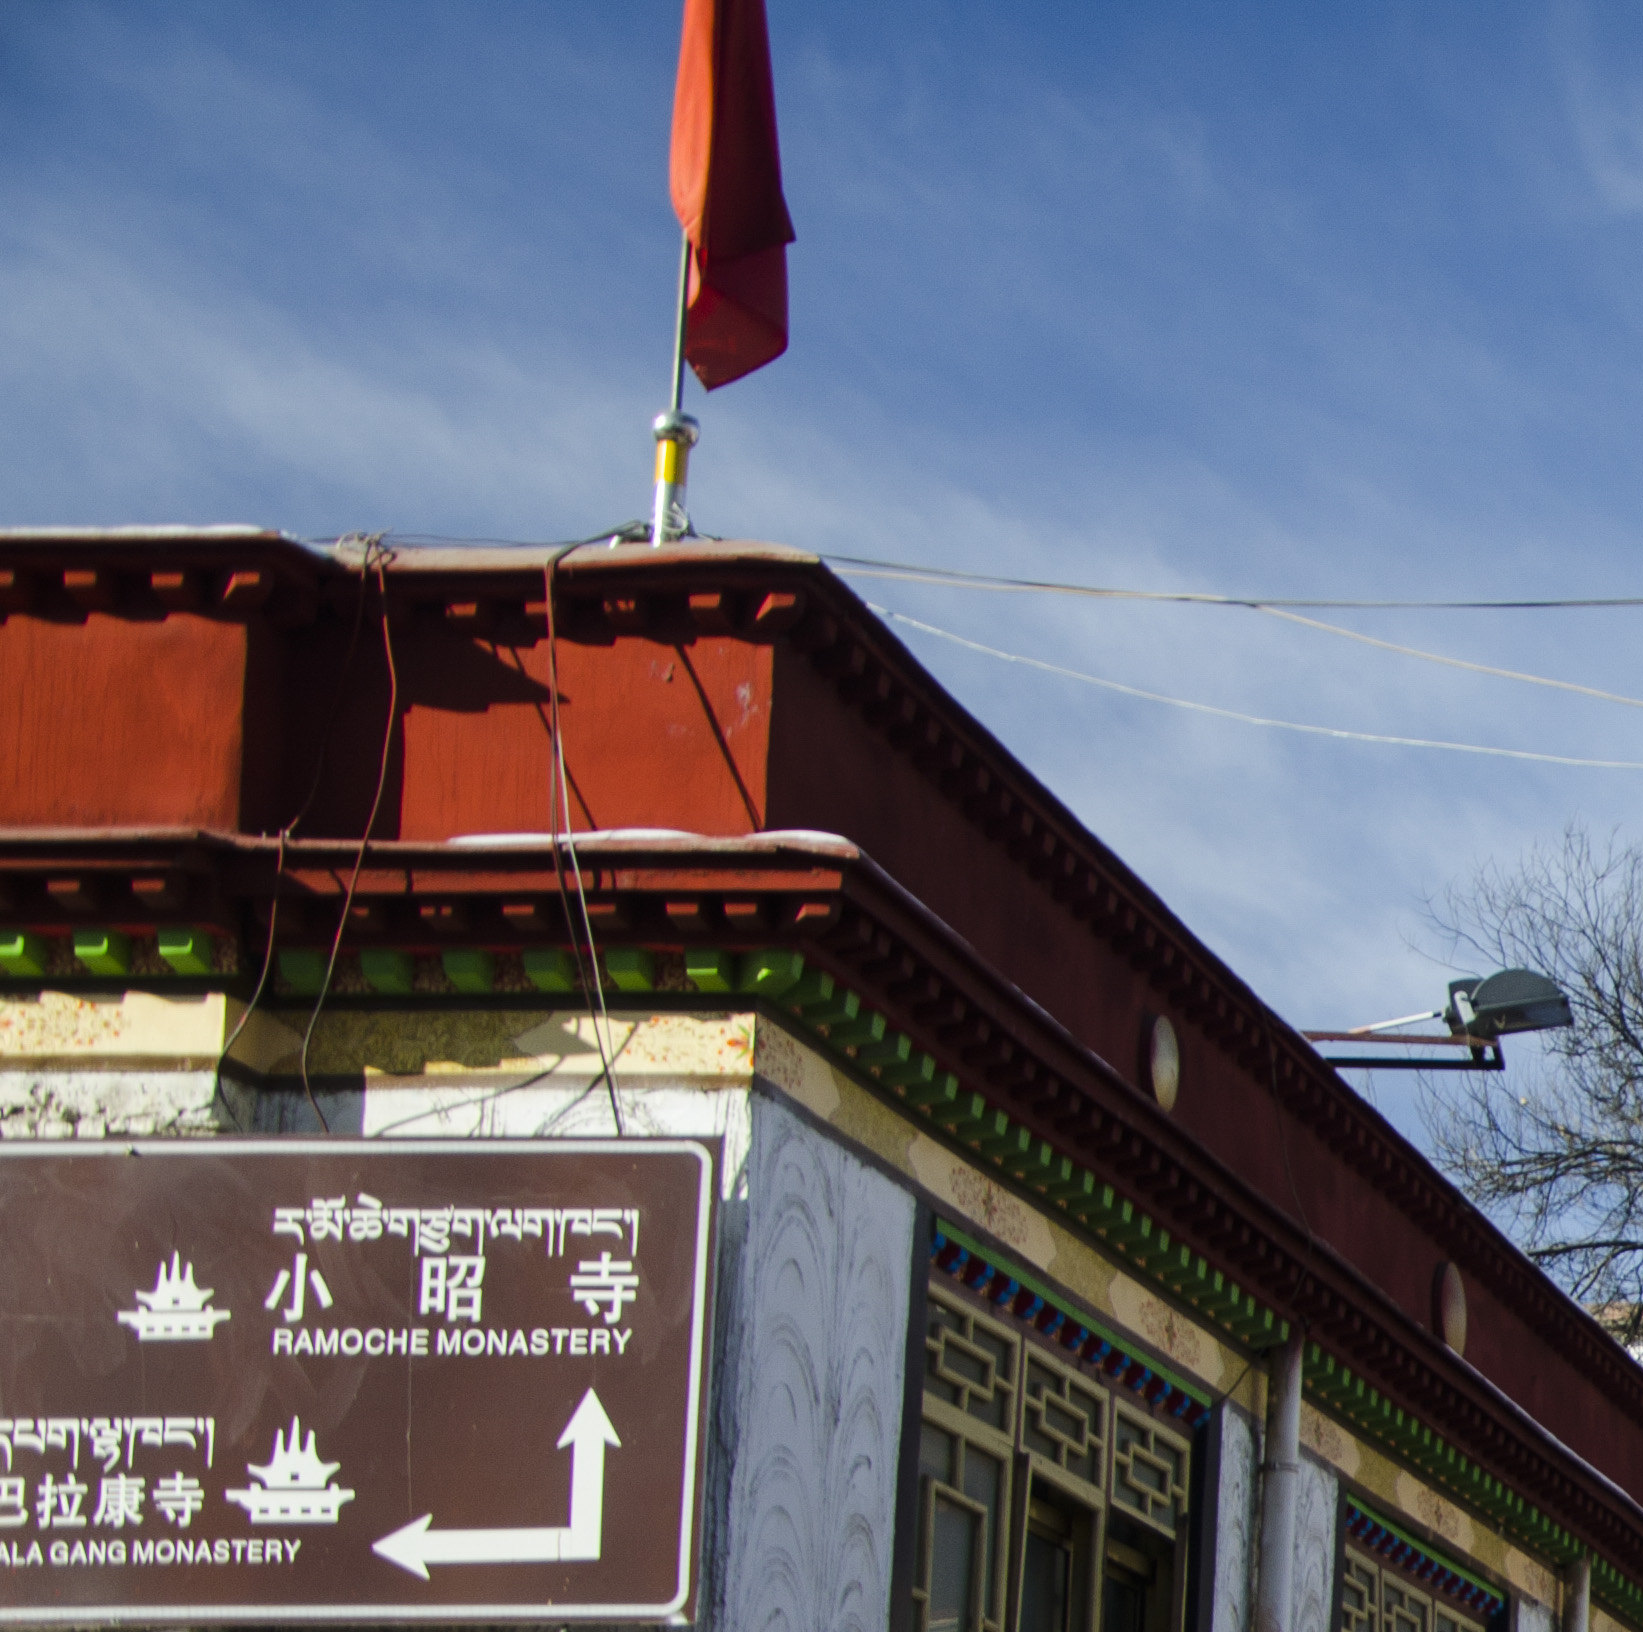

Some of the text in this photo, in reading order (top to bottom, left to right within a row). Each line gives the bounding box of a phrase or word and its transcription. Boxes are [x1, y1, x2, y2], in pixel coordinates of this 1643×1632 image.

[264, 1251, 640, 1325] 小昭寺
[272, 1328, 633, 1356] RAMOCHE MONASTERY
[49, 1538, 127, 1566] GANG
[132, 1538, 301, 1566] MONASTERY
